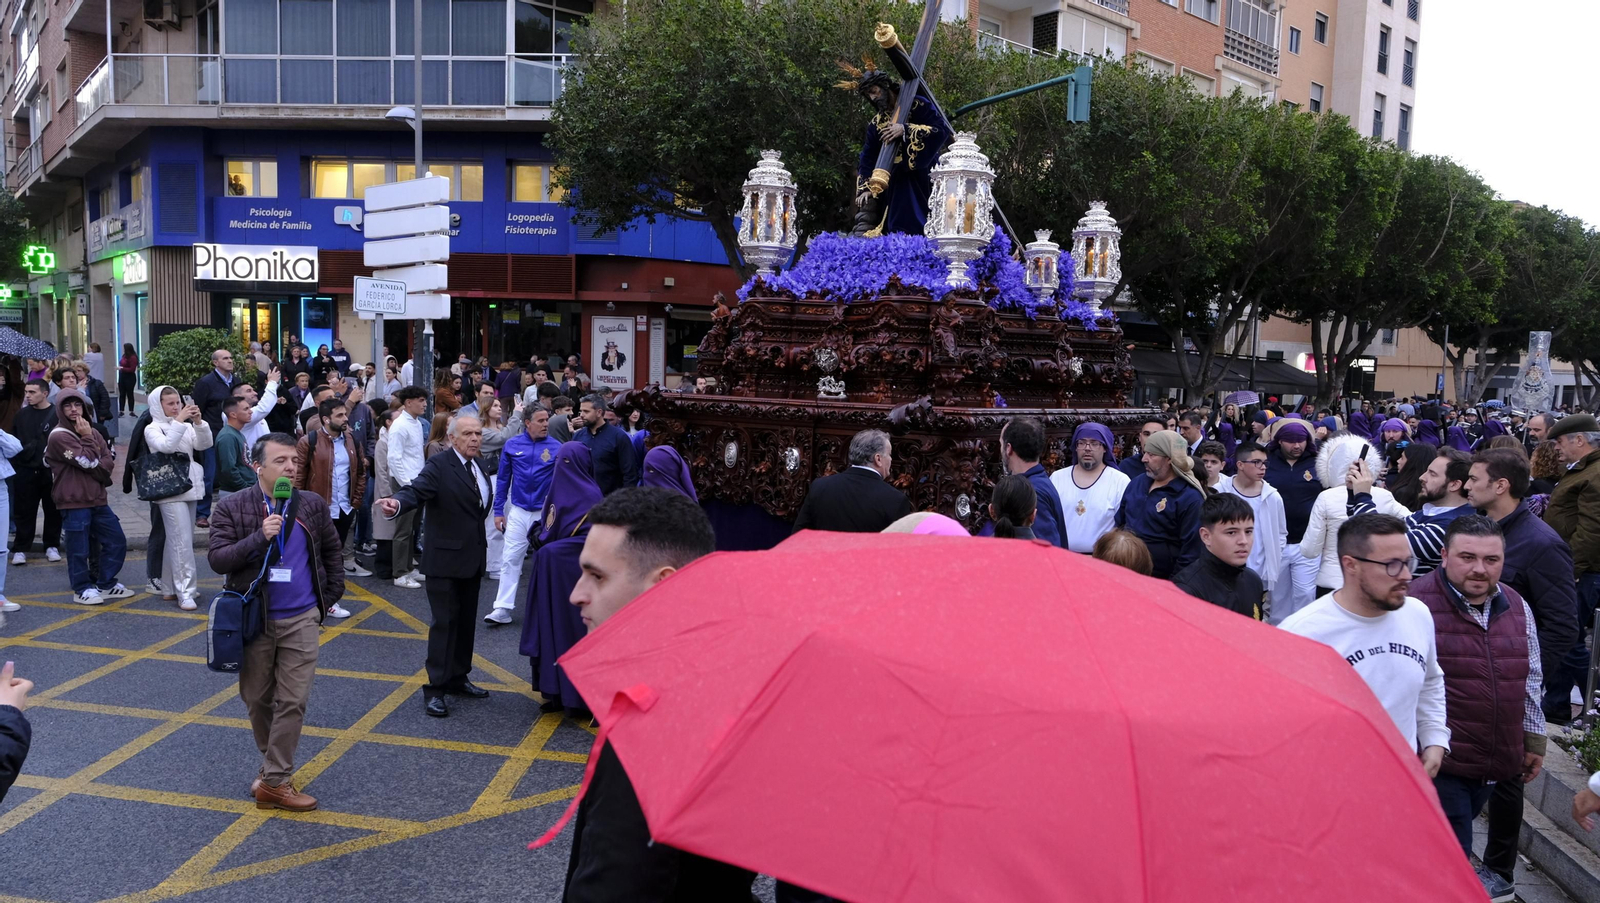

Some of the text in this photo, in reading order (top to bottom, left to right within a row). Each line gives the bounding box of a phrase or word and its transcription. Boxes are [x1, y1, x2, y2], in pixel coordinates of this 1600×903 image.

[507, 213, 555, 224] Logopedia
[229, 220, 268, 229] Medicina
[269, 221, 280, 229] de
[504, 225, 558, 237] Fisioterapia
[193, 245, 315, 281] Phonika
[370, 283, 404, 291] AVENIDA
[365, 290, 396, 301] FEDERICO
[358, 300, 403, 311] GARCÍA LORCA
[1368, 646, 1386, 656] DEL
